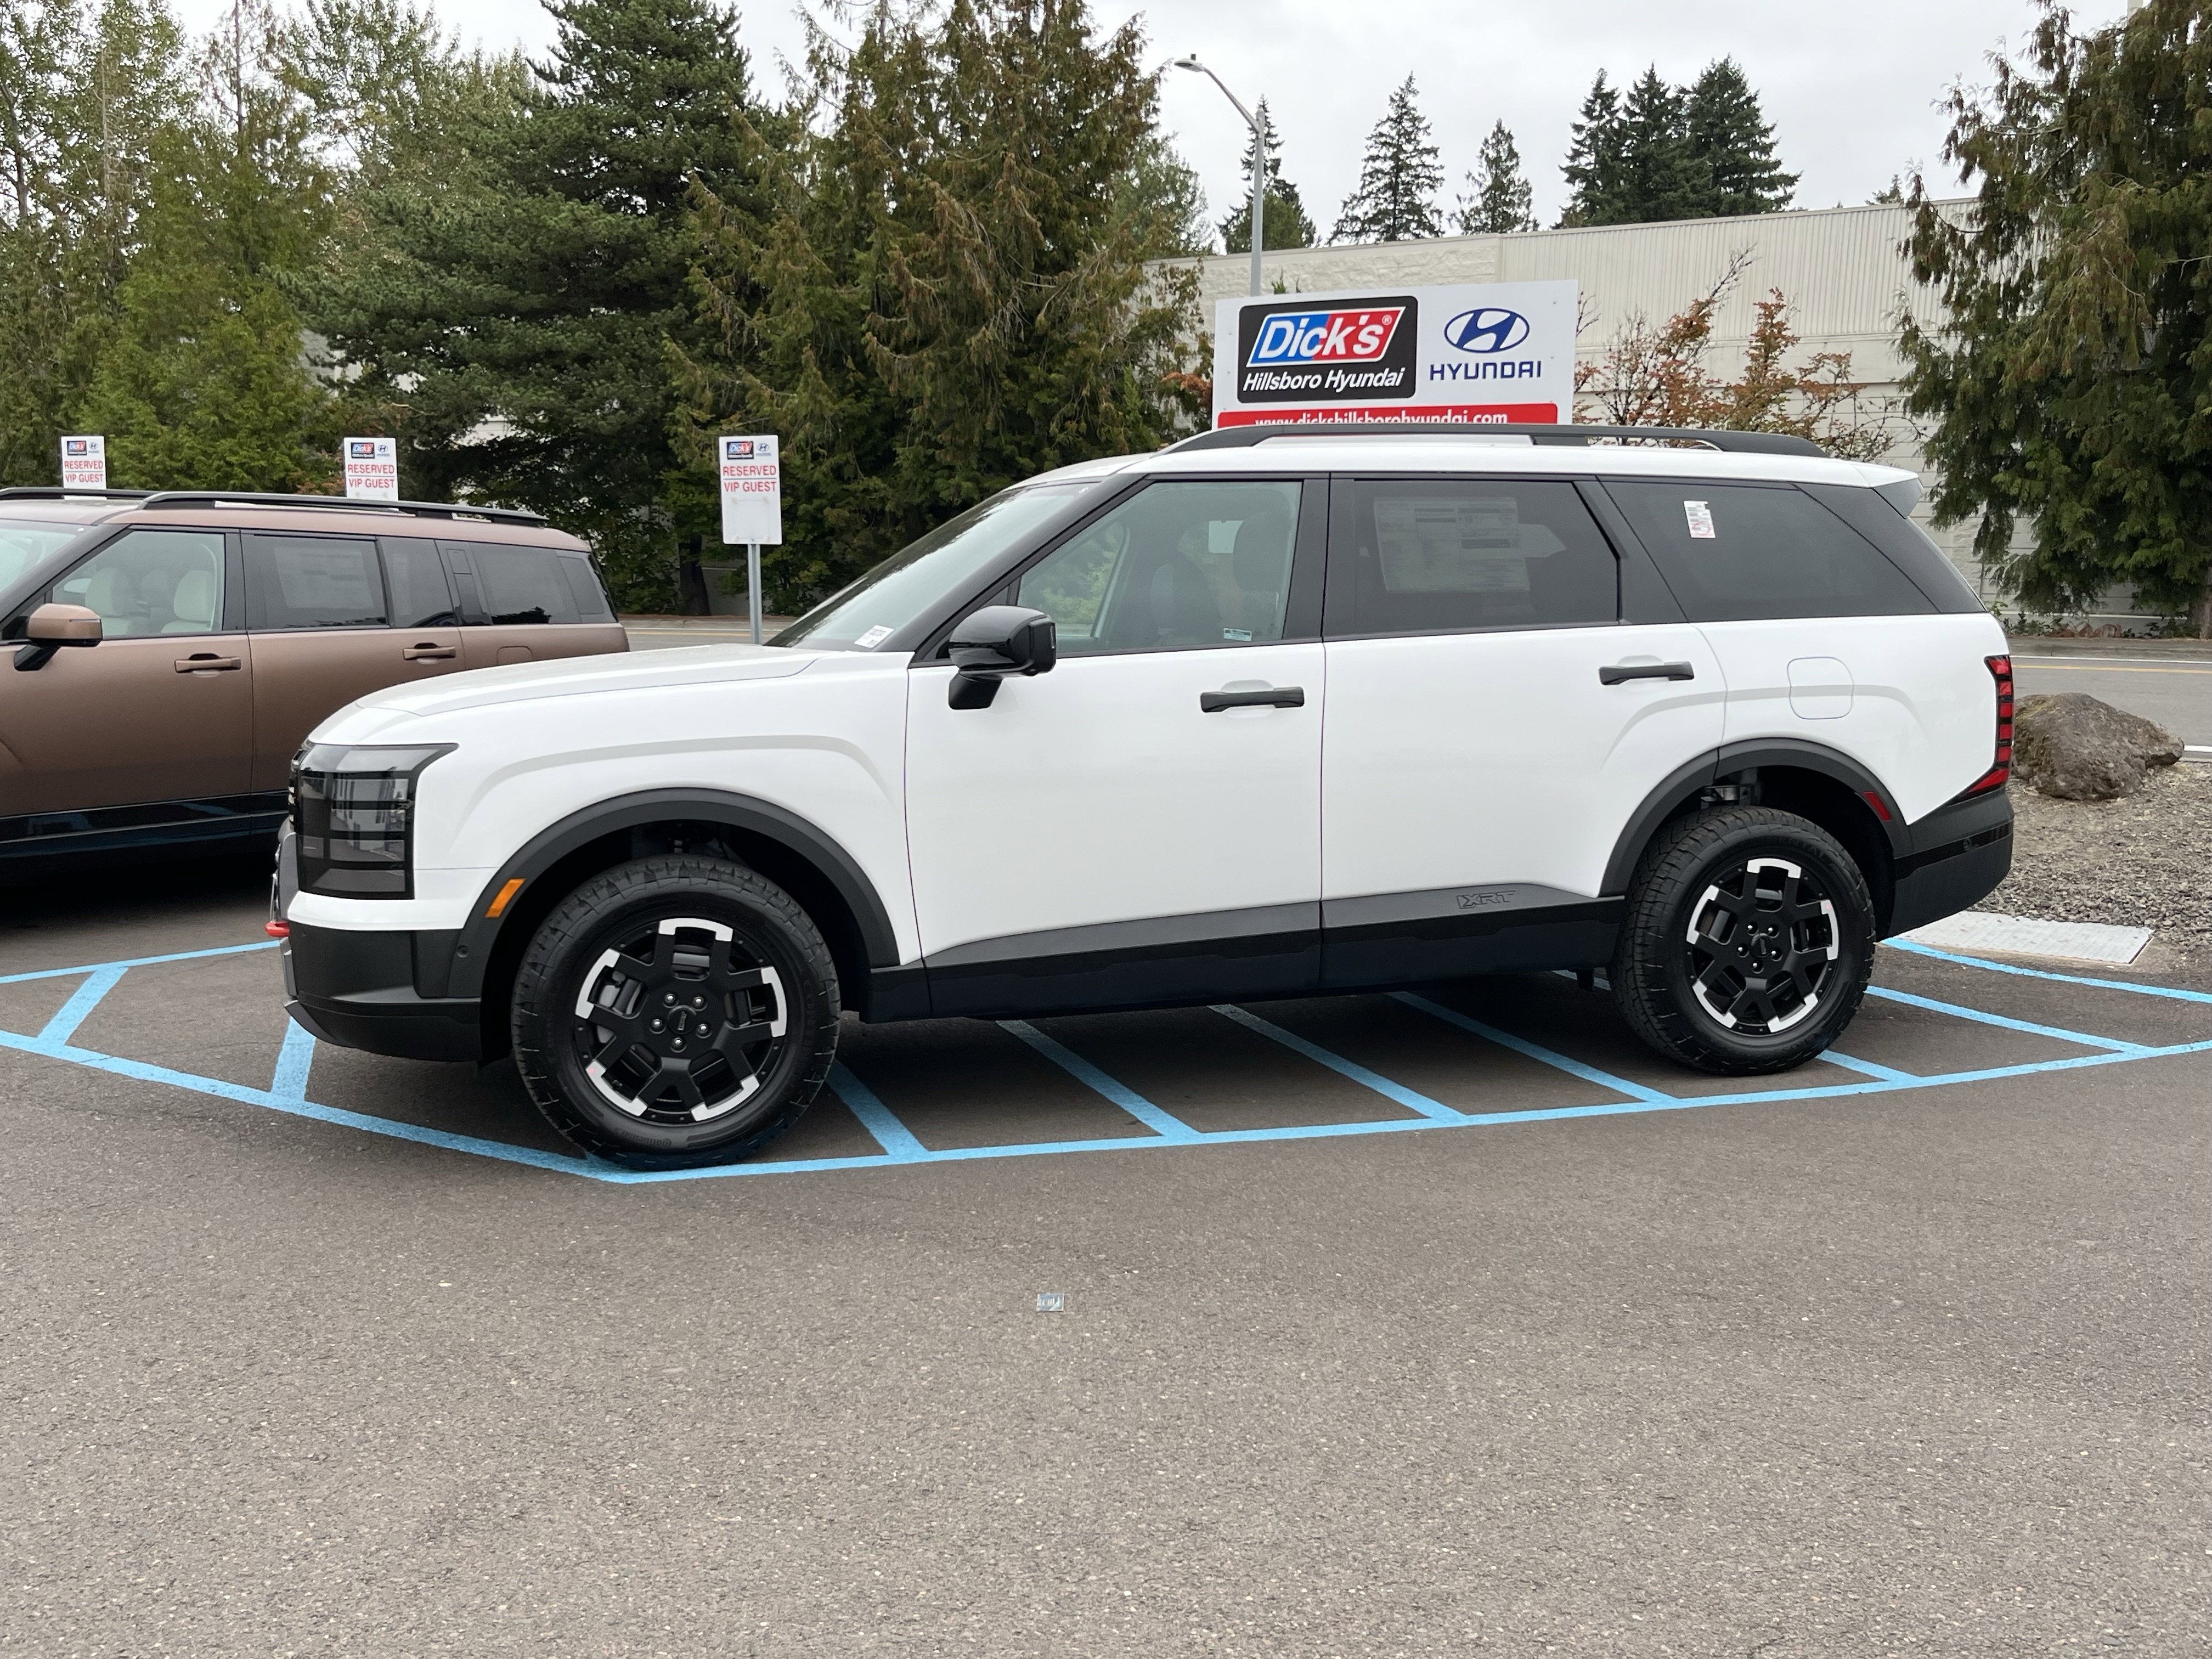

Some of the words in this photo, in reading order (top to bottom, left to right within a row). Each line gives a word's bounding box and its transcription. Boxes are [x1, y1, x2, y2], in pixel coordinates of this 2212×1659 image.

[1258, 314, 1384, 359] Dick's
[1430, 360, 1541, 381] HYUNDAI
[1243, 371, 1323, 391] Hillsboro
[1324, 367, 1406, 393] Hyundai
[1255, 409, 1508, 425] wwwdickshillsborohyundaicom
[64, 461, 103, 469] RESERVED
[347, 464, 394, 473] RESERVED
[723, 465, 776, 476] RESERVED
[65, 474, 77, 482] VIP
[79, 473, 103, 482] GUEST
[348, 478, 362, 488] VIP
[365, 478, 395, 488] GUEST
[724, 482, 739, 492] VIP
[742, 481, 776, 492] GUEST
[1457, 890, 1516, 909] XRT
